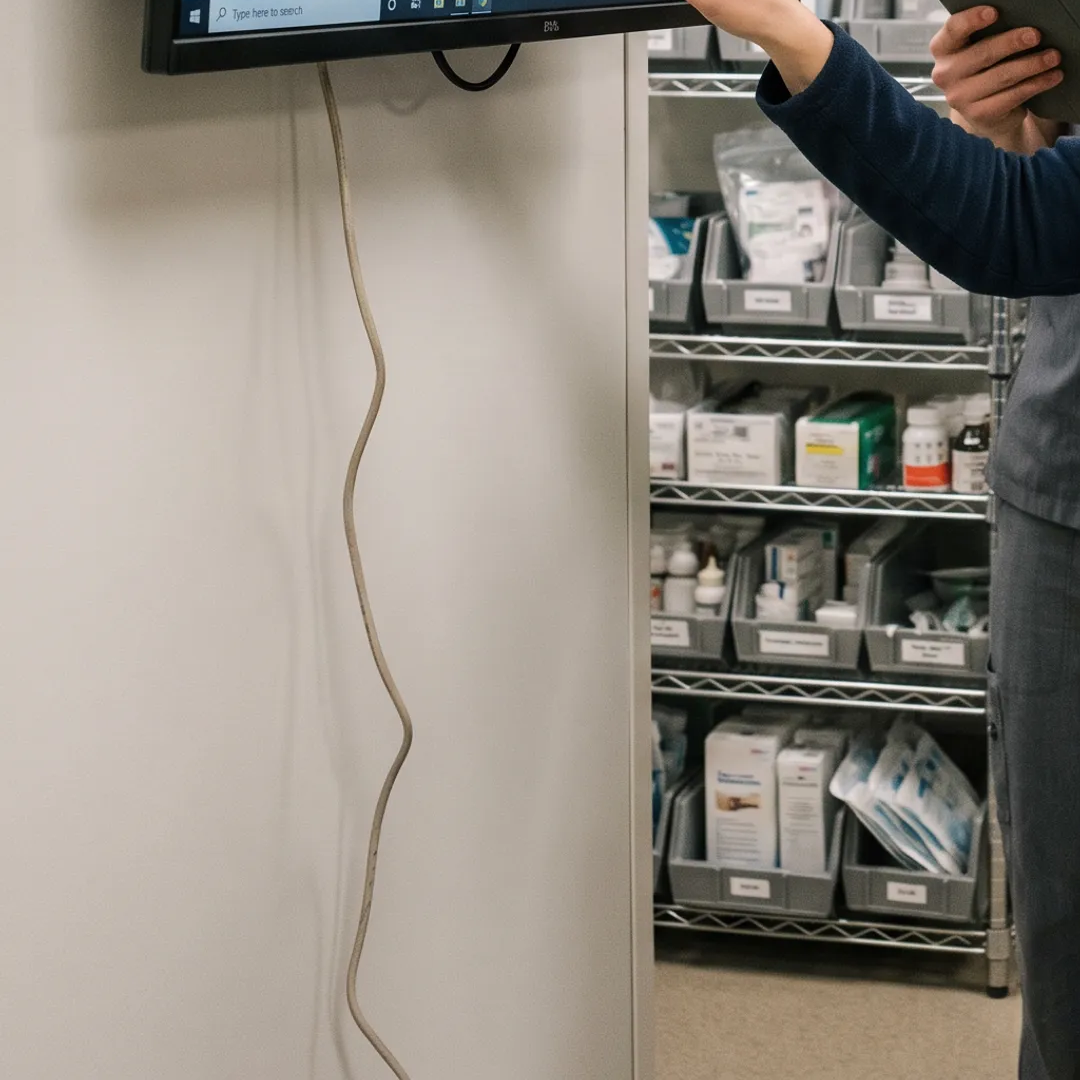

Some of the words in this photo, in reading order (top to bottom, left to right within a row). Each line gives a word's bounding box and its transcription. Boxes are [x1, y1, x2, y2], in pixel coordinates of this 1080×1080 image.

[233, 9, 250, 21] Type
[252, 8, 268, 18] here
[270, 8, 278, 16] to
